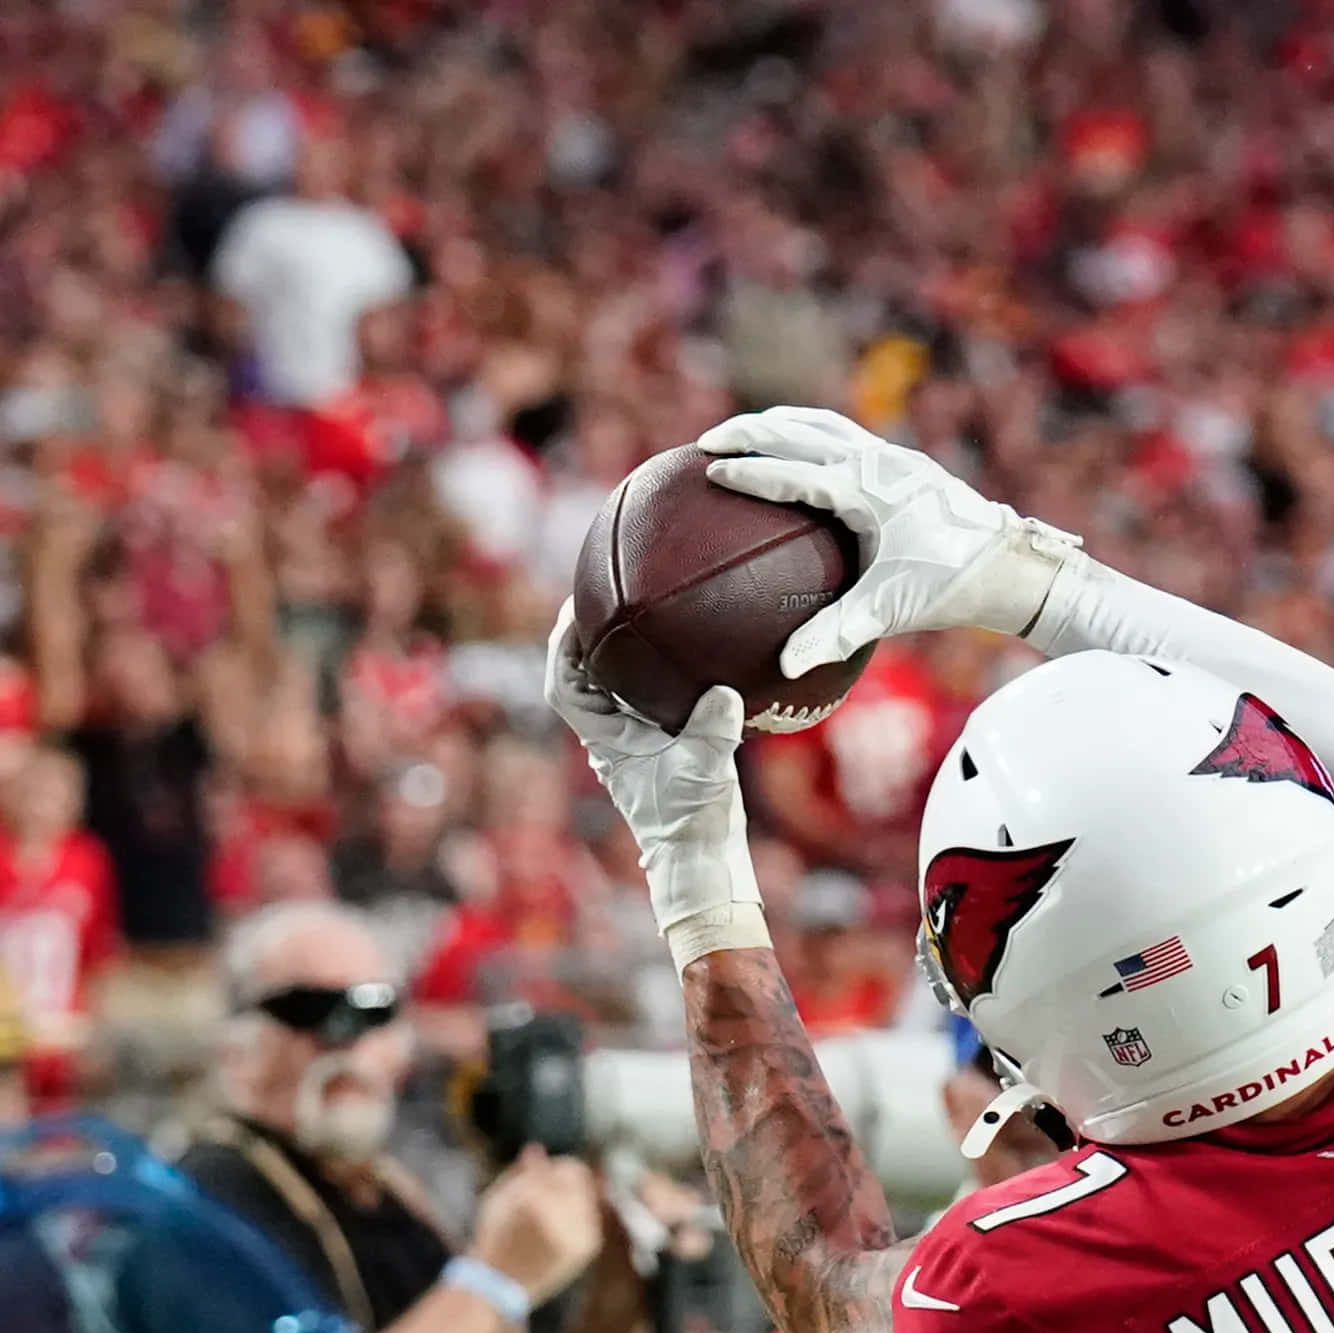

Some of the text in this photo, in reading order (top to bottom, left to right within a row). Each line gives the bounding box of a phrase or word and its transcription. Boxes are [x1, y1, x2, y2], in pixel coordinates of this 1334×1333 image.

[1247, 943, 1281, 1016] 7
[1113, 1042, 1148, 1062] NFL
[966, 1150, 1130, 1235] 7
